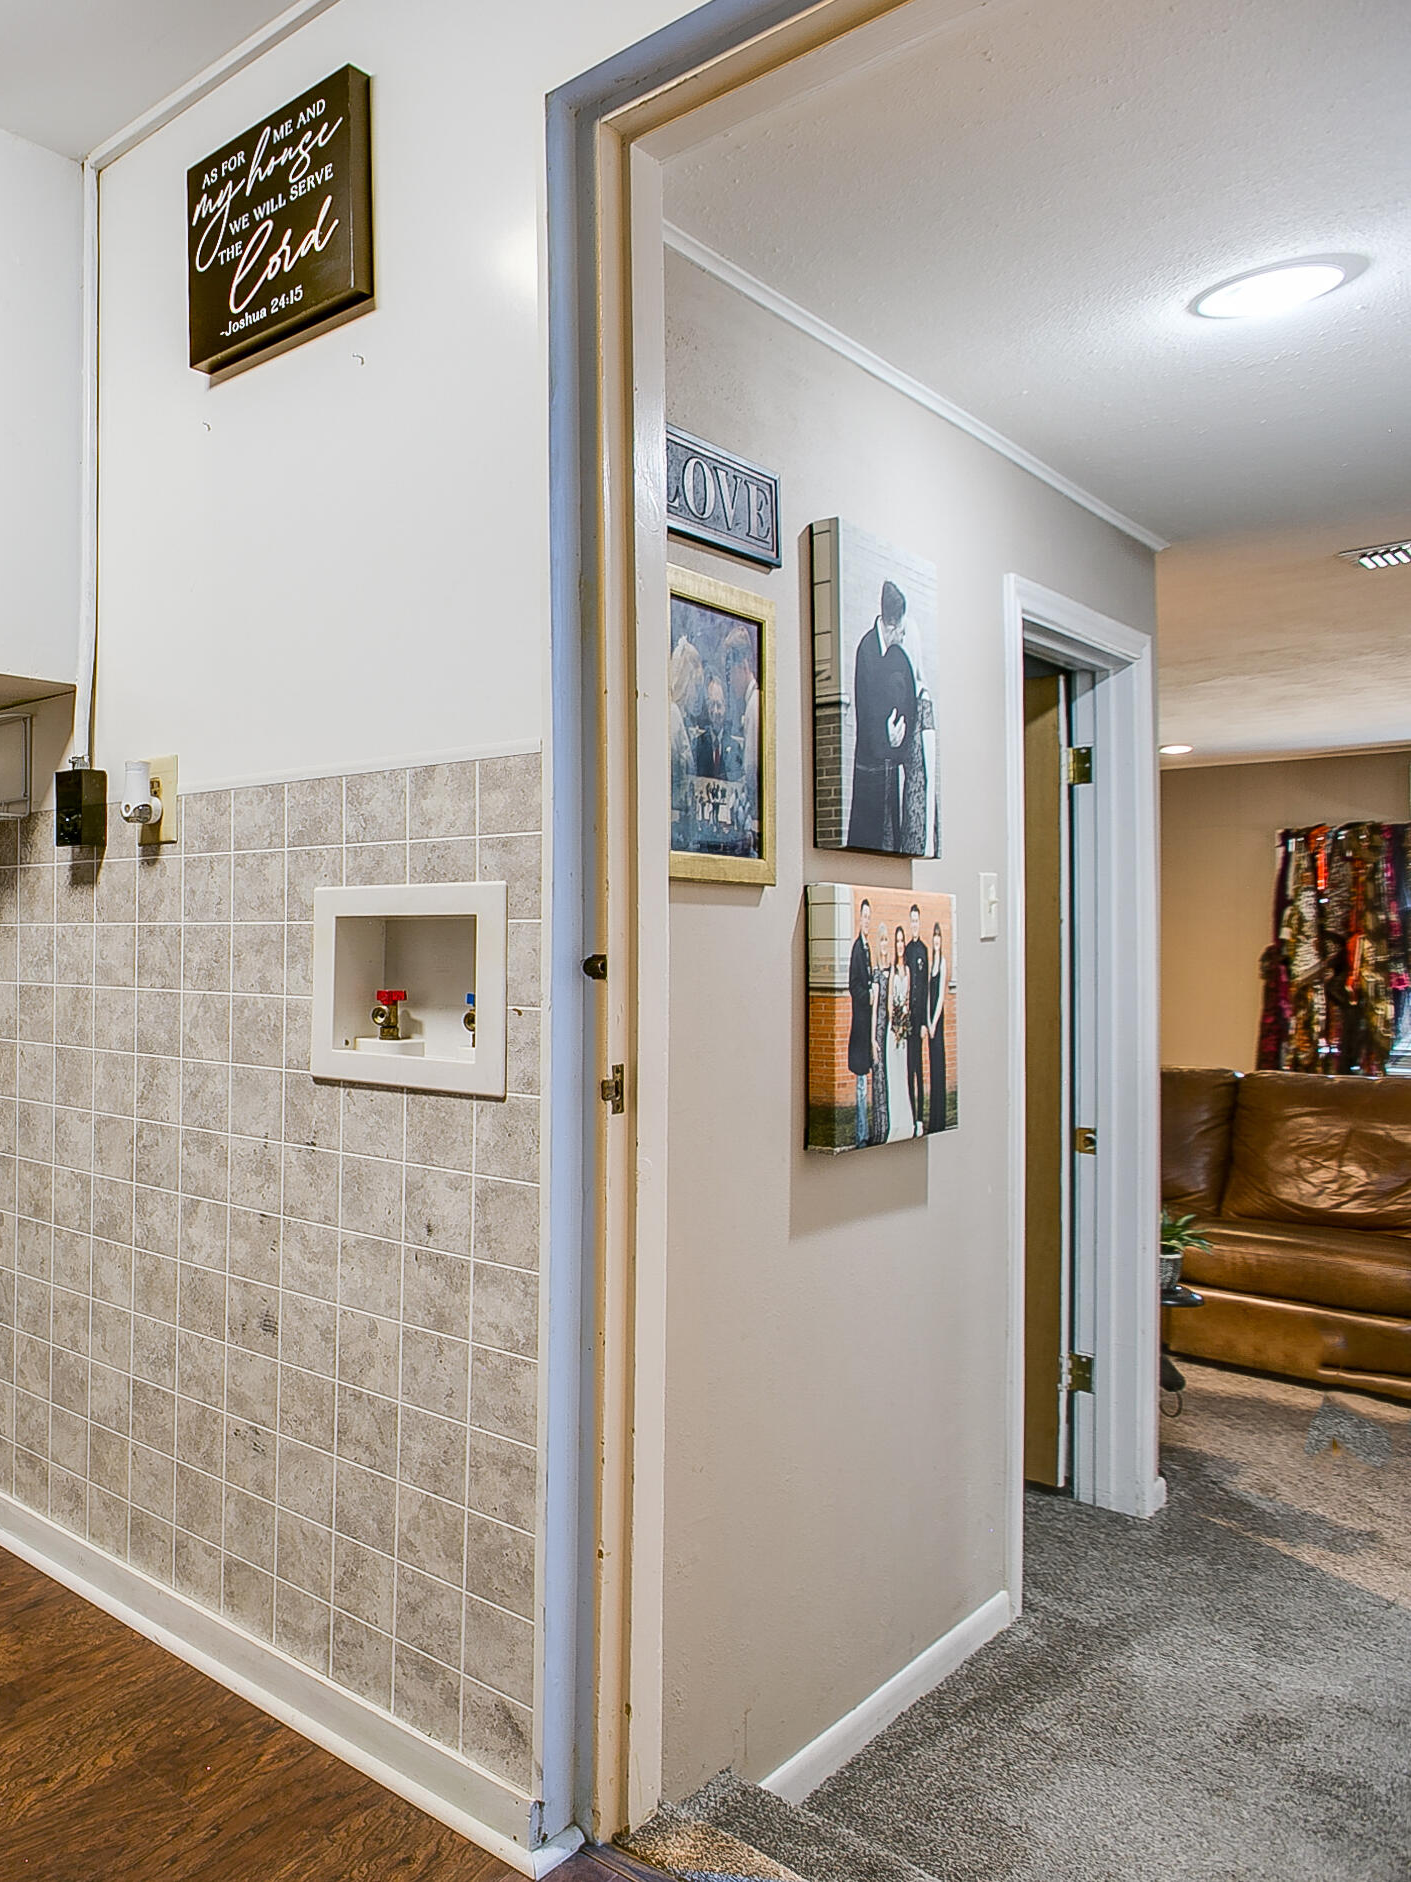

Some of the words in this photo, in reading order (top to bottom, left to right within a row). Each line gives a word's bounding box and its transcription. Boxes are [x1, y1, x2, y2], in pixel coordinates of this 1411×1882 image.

[201, 167, 219, 190] AS
[220, 150, 247, 179] FOR
[272, 119, 294, 146] ME
[296, 98, 327, 130] AND
[192, 178, 246, 272] my
[245, 126, 344, 197] house
[228, 212, 250, 237] WE
[252, 193, 287, 222] WILL
[289, 162, 335, 201] SERVE
[218, 240, 244, 266] THE
[270, 284, 305, 312] 24:15
